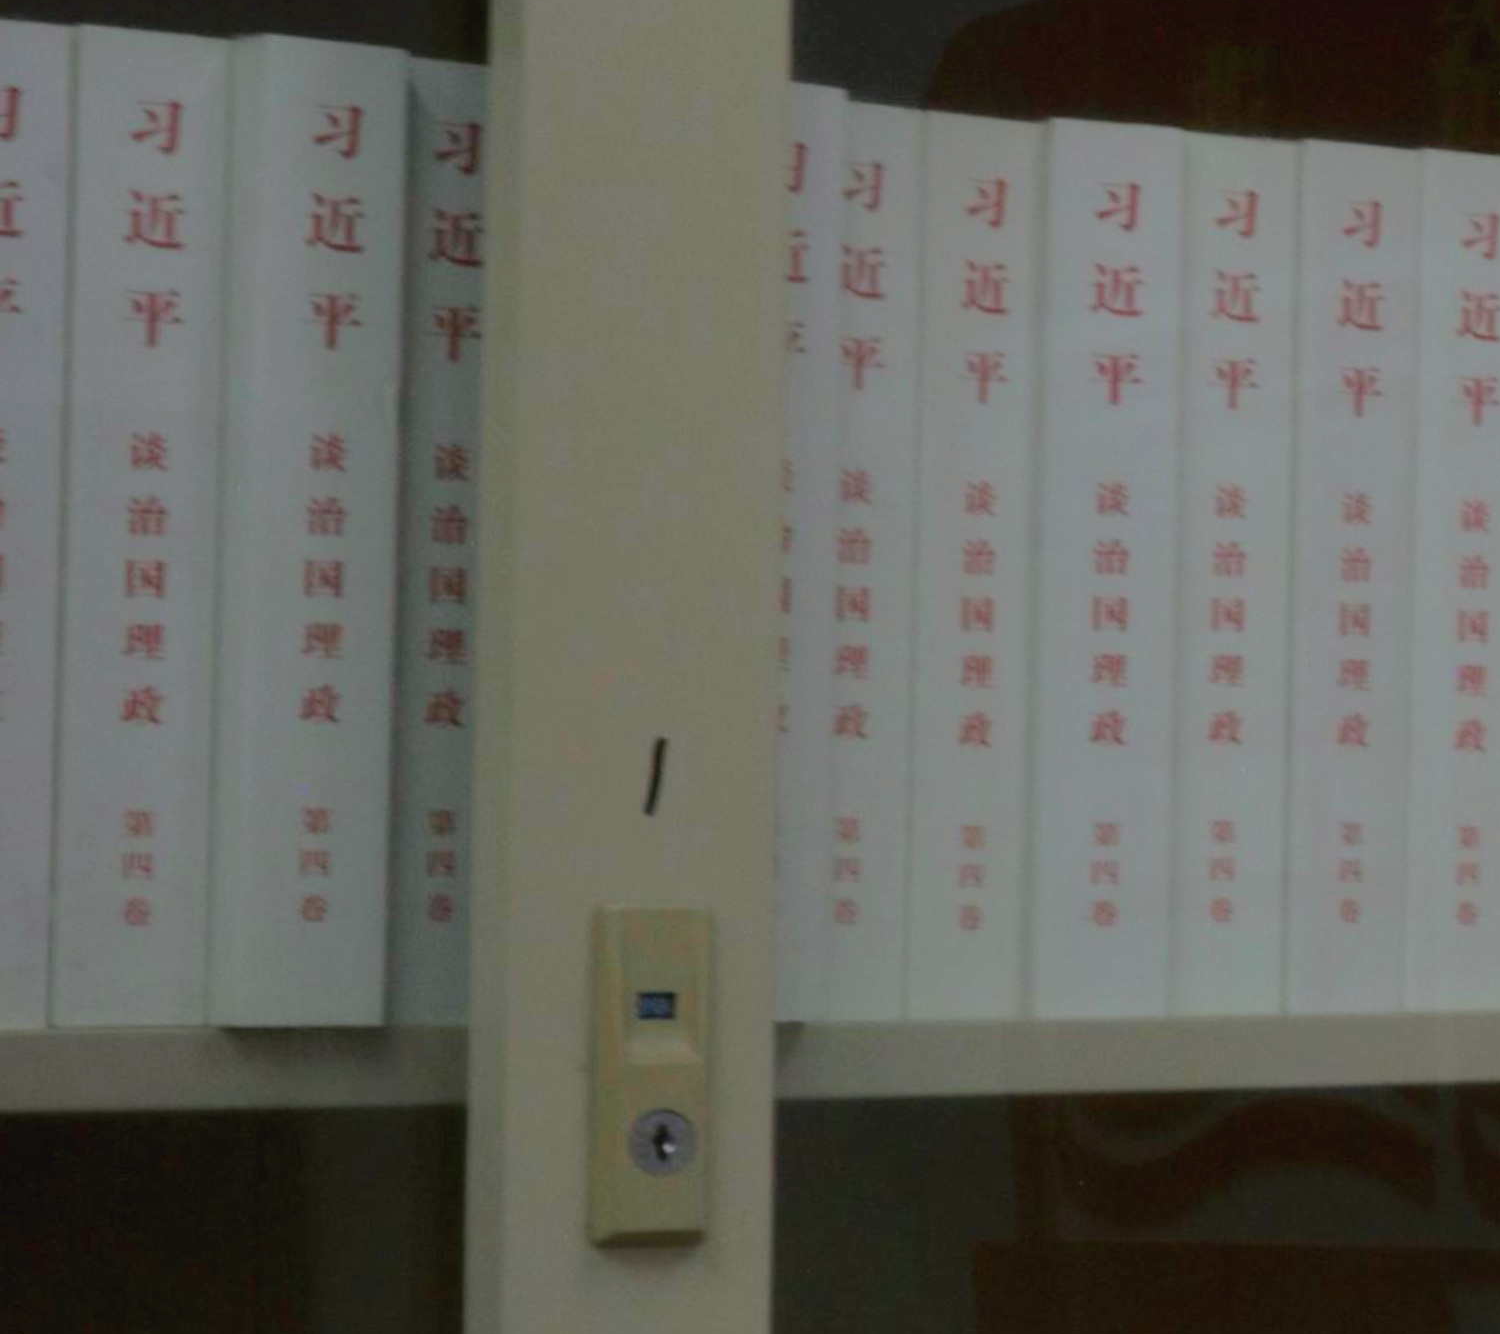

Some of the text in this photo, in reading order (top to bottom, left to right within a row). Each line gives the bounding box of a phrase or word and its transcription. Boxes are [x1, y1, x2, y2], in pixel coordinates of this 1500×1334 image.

[839, 161, 886, 391] 习近平
[962, 177, 1010, 404] 习近平
[1091, 181, 1143, 407] 习近平
[1212, 189, 1261, 411] 习近平
[1337, 199, 1384, 417] 习近平
[121, 99, 186, 929] 习近平 谈治国理政 第四卷
[299, 104, 366, 924] 习近平 谈治国理政 第四卷
[424, 120, 484, 924] 习近平 谈治国理政 第四卷
[832, 470, 872, 739] 谈治国理政
[958, 481, 996, 749] 谈治国理政
[1090, 483, 1131, 747] 谈治国理政
[1207, 487, 1248, 745] 谈治国理政
[1336, 493, 1372, 748] 谈治国理政
[1454, 500, 1491, 753] 谈治国理政
